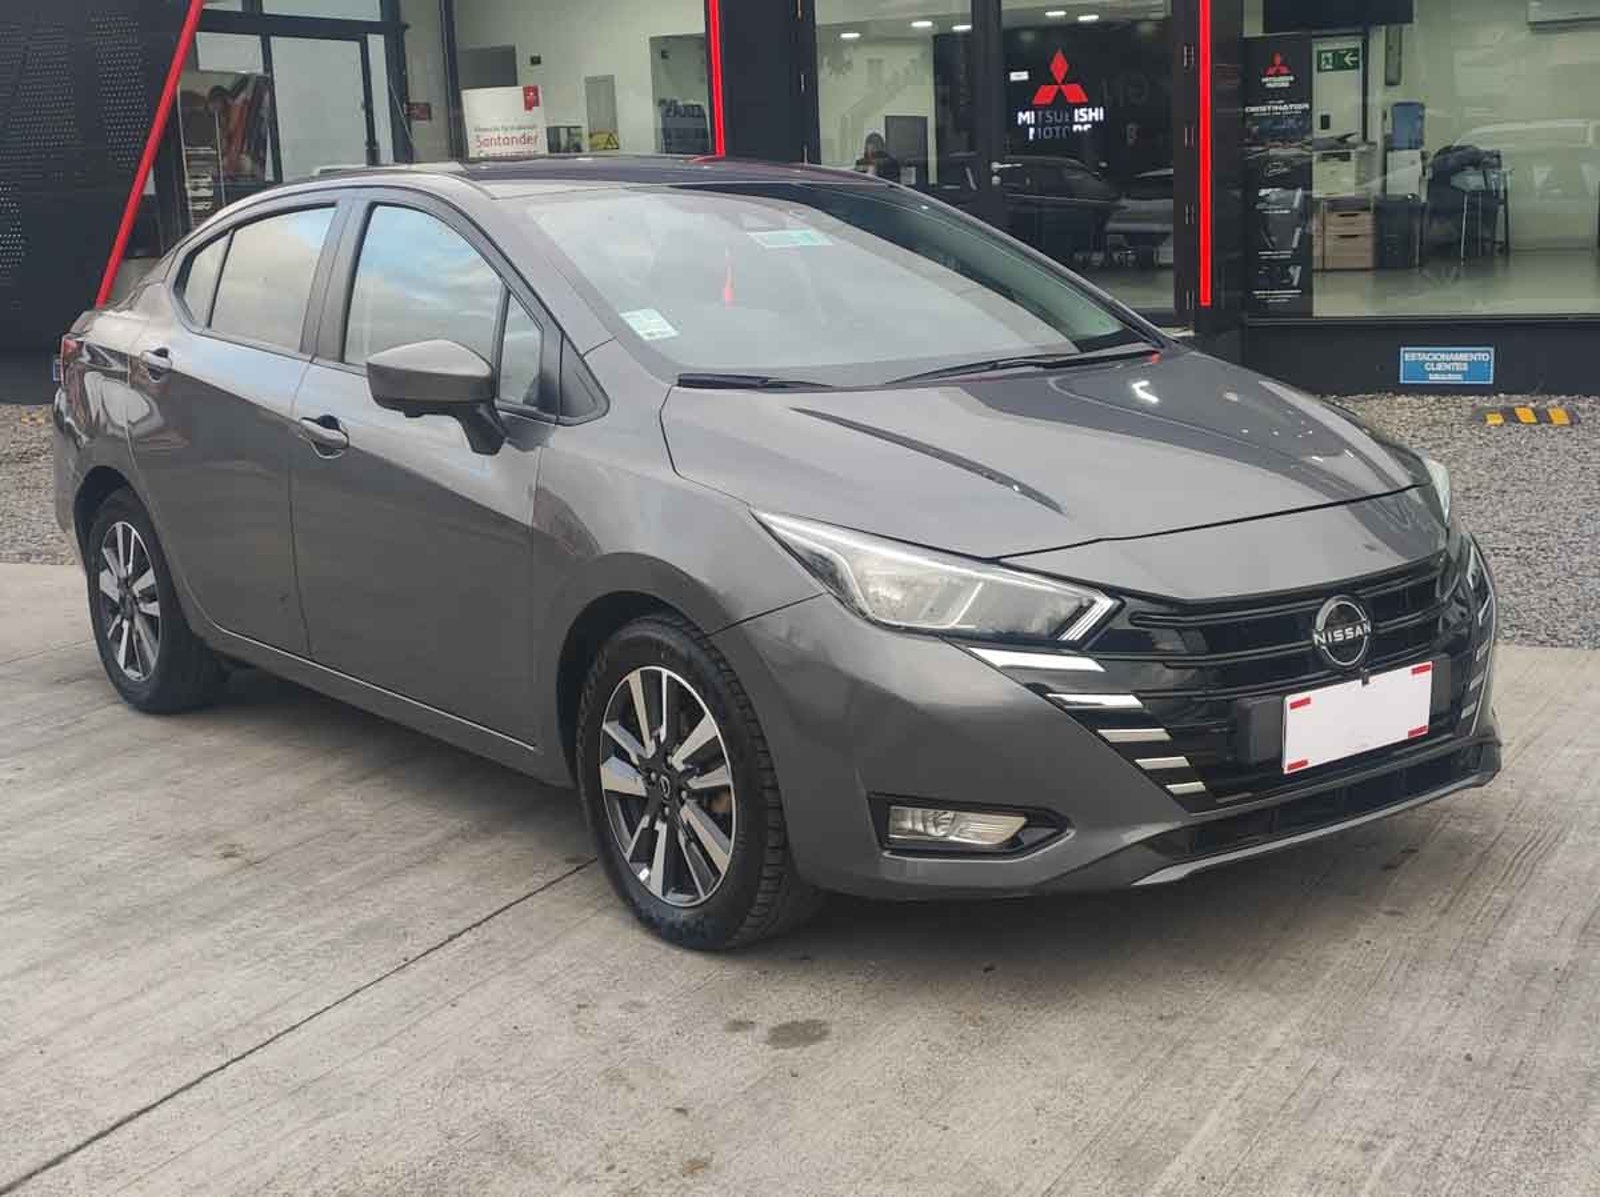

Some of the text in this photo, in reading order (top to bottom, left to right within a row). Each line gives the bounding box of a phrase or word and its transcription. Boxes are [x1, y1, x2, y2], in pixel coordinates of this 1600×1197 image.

[475, 132, 539, 149] Santander
[1404, 352, 1490, 362] ESTACIONAMIENTO
[1424, 362, 1469, 372] CLIENTES
[1313, 621, 1371, 646] NISSAN
